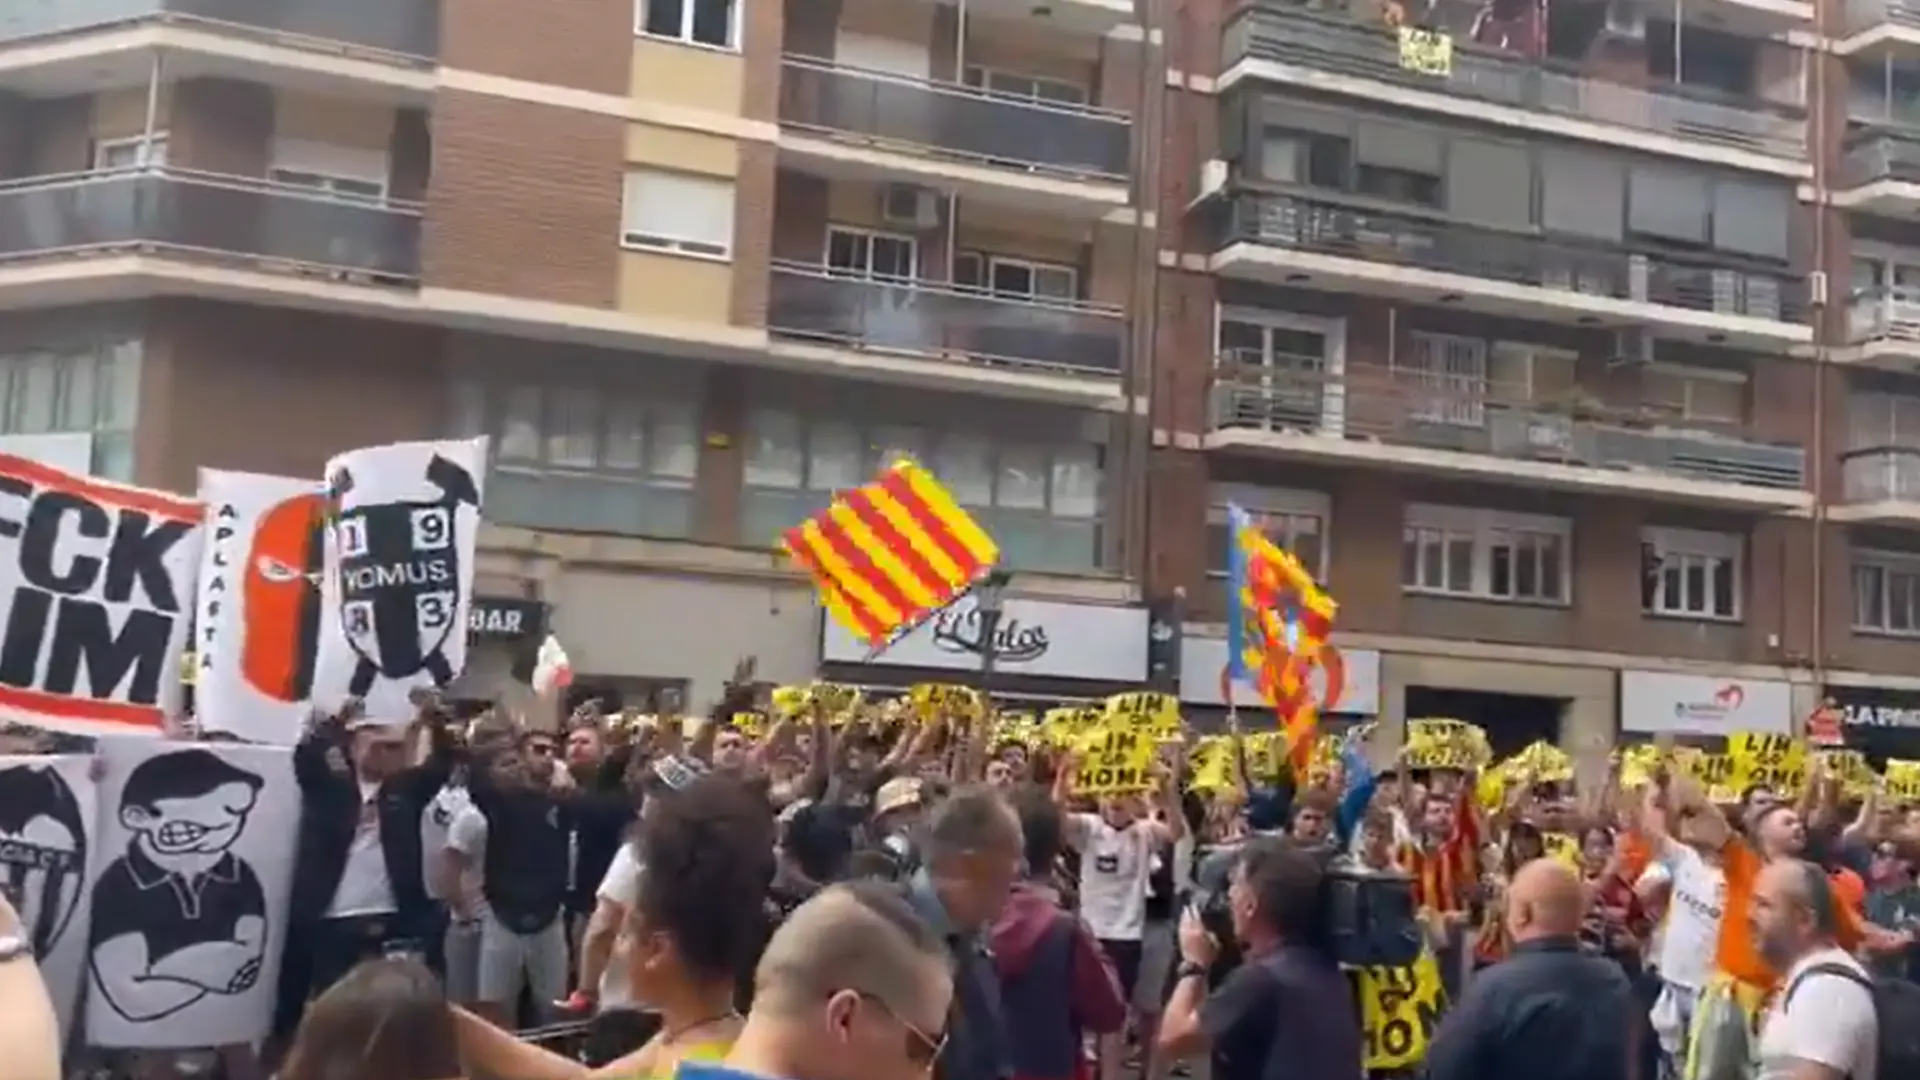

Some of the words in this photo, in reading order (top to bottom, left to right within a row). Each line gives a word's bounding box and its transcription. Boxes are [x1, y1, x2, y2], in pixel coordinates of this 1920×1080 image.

[420, 513, 443, 543] 9
[200, 503, 236, 669] APLASTA
[344, 560, 449, 592] YOMUS
[420, 598, 446, 628] 3
[470, 608, 523, 632] BAR
[1118, 694, 1163, 713] LIM
[1745, 733, 1792, 752] LIM
[1101, 753, 1127, 766] GO
[1075, 767, 1151, 788] HOME
